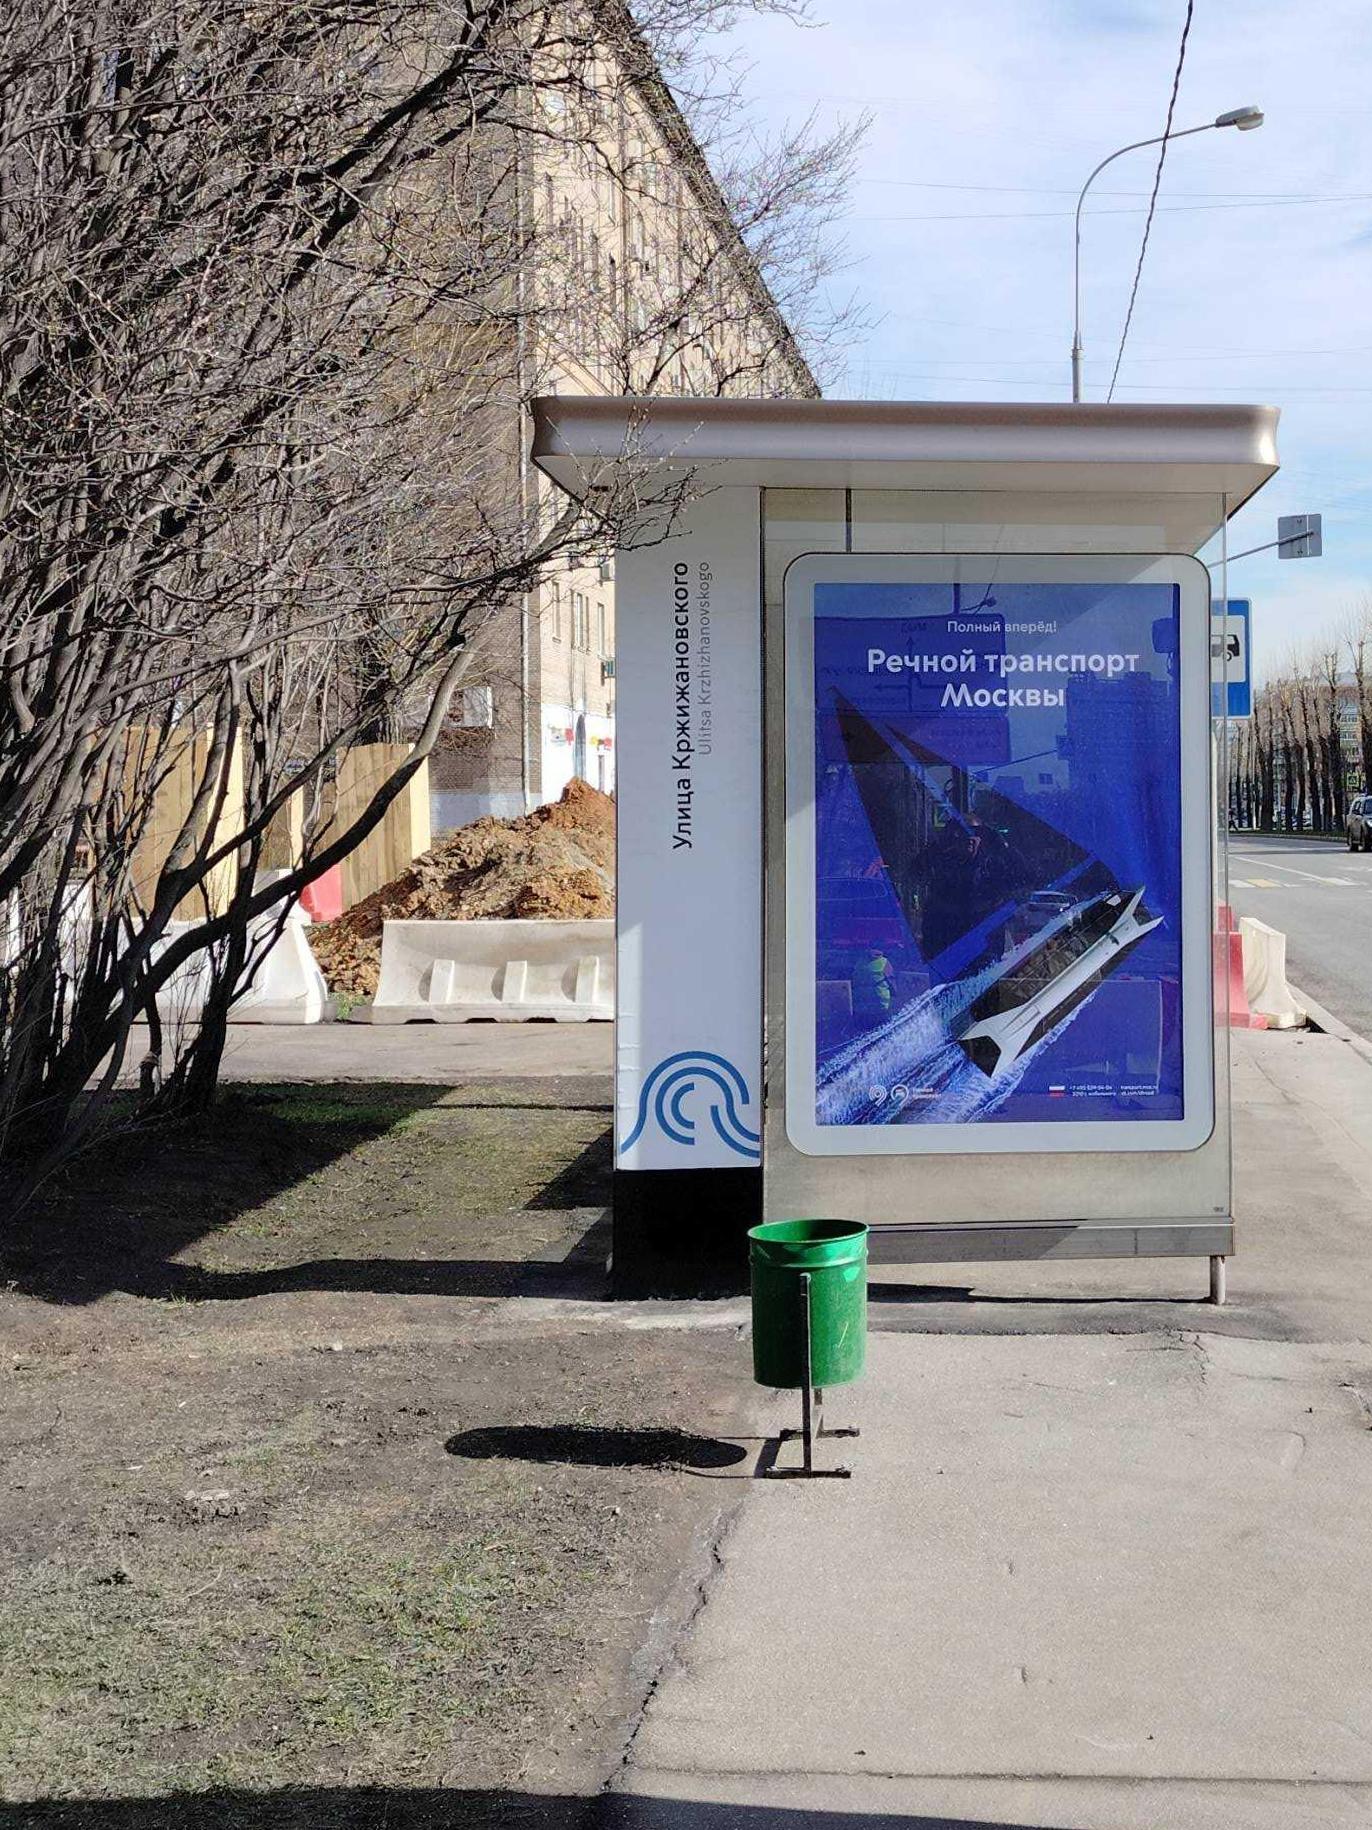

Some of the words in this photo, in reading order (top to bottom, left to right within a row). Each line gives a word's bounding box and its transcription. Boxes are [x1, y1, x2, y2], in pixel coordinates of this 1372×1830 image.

[696, 561, 713, 705] Krzhizhanovskogo
[947, 619, 1000, 634] Полный
[1004, 619, 1057, 634] вперёд!
[672, 562, 694, 771] Кржижановского
[867, 649, 976, 673] Речной
[984, 652, 1140, 677] транспорт
[941, 682, 1064, 707] Москвы
[697, 709, 712, 755] Ulitsa
[672, 777, 693, 849] Улица
